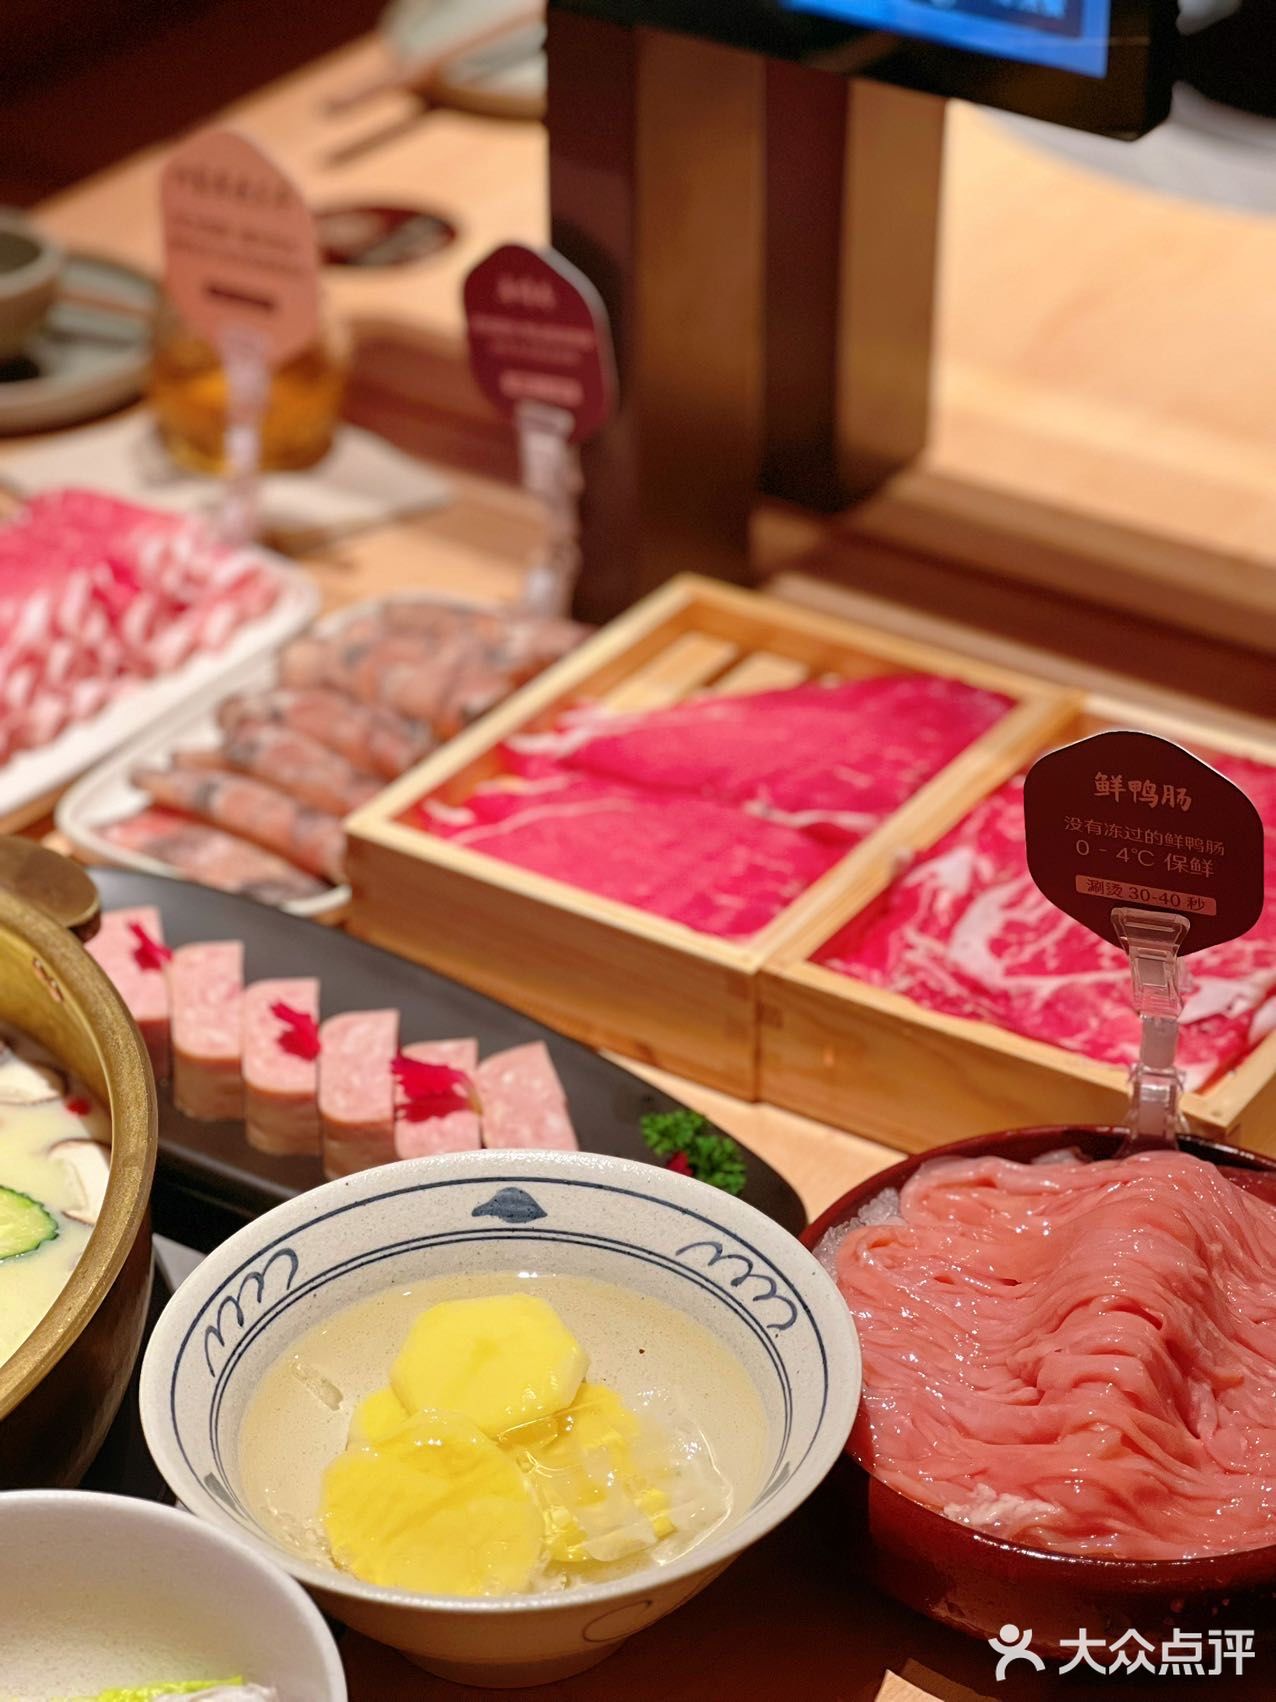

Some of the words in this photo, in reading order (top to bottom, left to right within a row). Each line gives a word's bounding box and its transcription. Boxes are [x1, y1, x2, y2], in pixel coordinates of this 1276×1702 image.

[1093, 771, 1193, 812] 鲜鸭肠
[1063, 815, 1225, 857] 没有冻过的鲜鸭肠
[1164, 853, 1214, 878] 保鲜
[1086, 878, 1124, 897] 涮烫
[1128, 887, 1181, 907] 30-40
[1186, 897, 1206, 912] 秒
